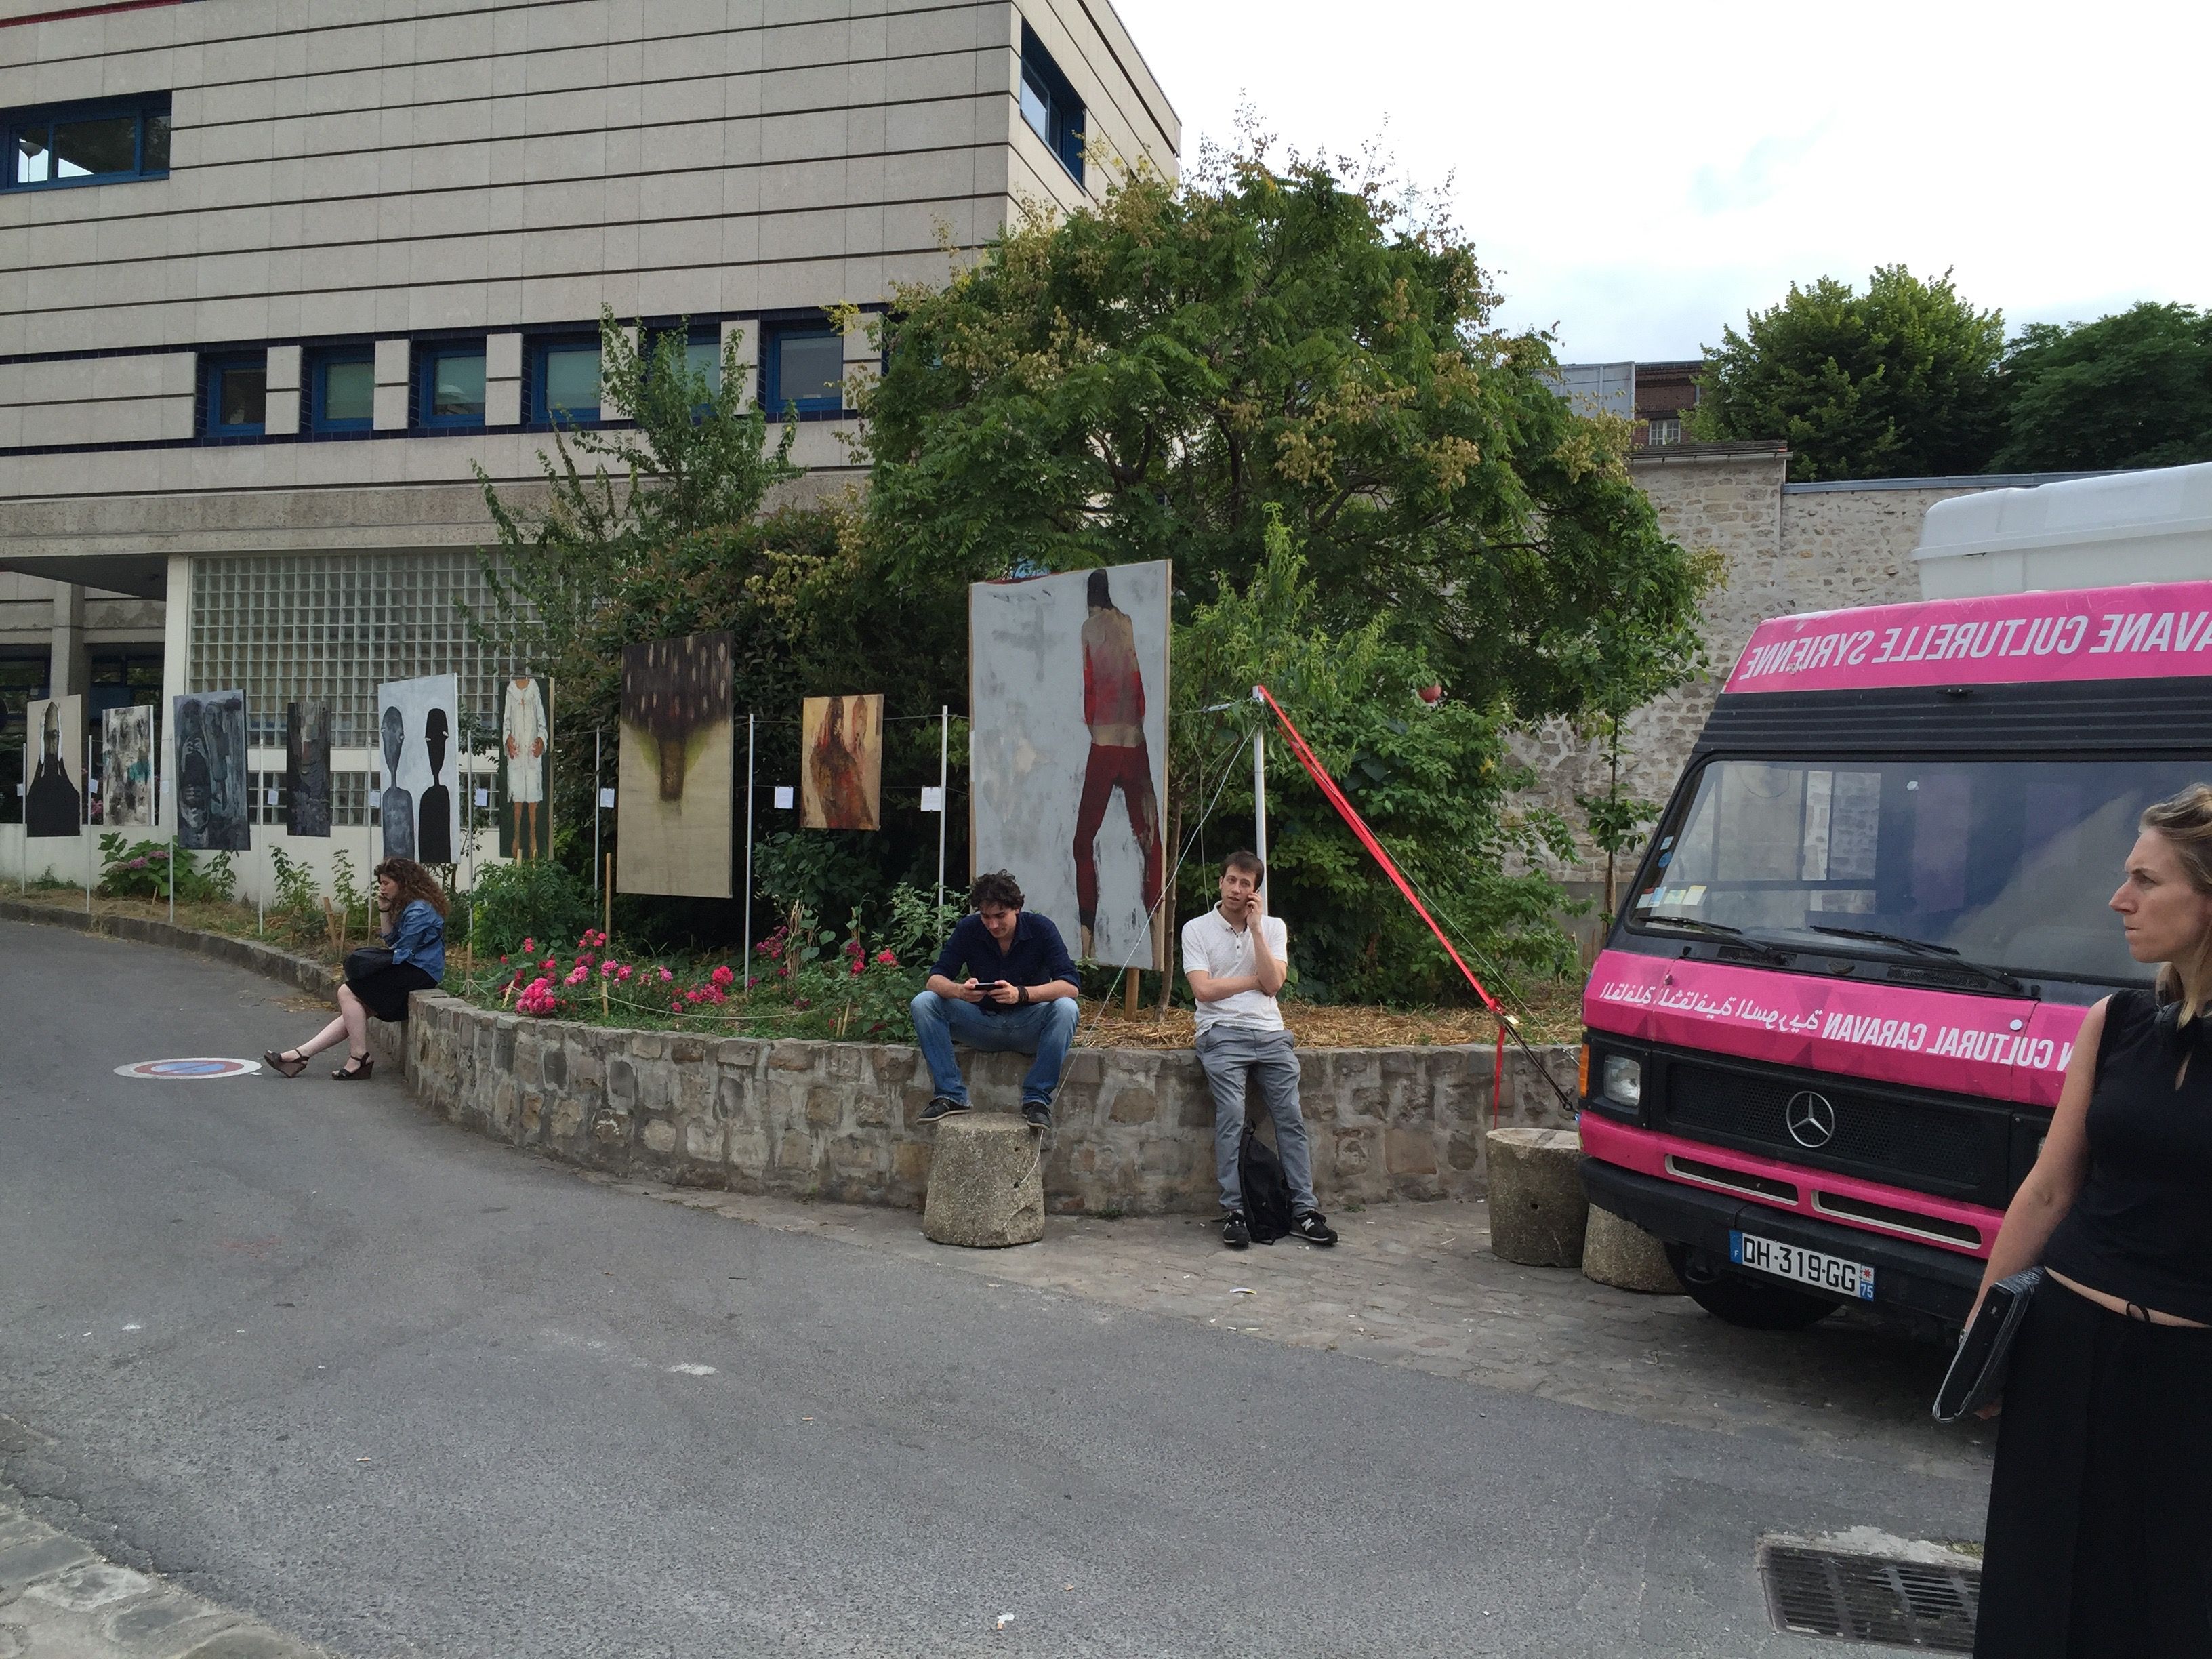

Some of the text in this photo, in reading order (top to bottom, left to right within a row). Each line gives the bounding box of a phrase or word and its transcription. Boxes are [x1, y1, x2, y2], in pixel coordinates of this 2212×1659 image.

[1734, 1250, 1740, 1258] F
[1743, 1236, 1856, 1292] DH-319-GG
[1860, 1283, 1874, 1299] 75
